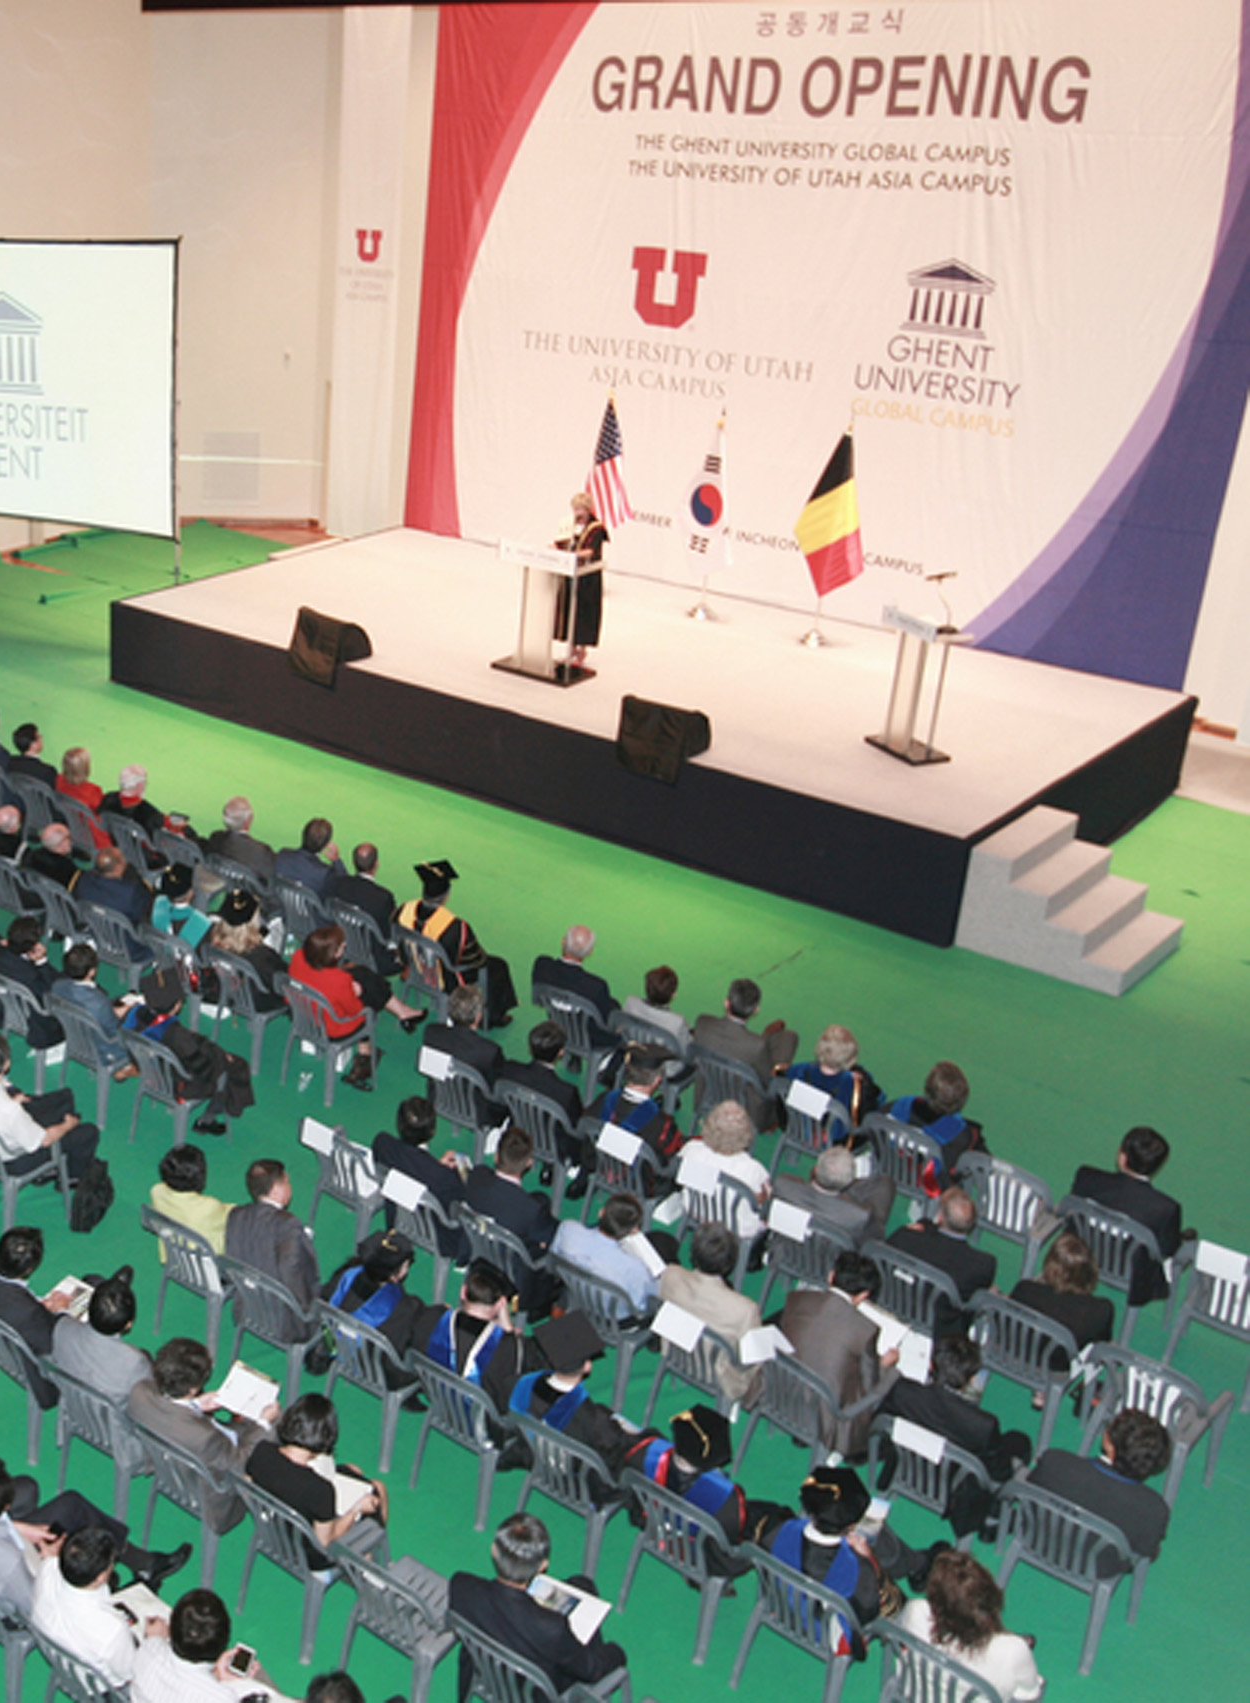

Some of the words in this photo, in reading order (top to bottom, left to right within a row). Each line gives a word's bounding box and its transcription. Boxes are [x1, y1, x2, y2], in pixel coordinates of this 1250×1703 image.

[592, 54, 782, 115] GRAND
[800, 53, 1092, 124] OPENING
[635, 133, 665, 151] THE
[670, 134, 730, 155] GHENT
[735, 139, 838, 160] UNIVERSITY
[843, 142, 918, 162] GLOBAL
[924, 142, 1011, 167] CAMPUS
[628, 159, 658, 177] THE
[662, 160, 768, 184] UNIVERSITY
[772, 167, 802, 186] OF
[808, 168, 862, 188] UTAH
[867, 170, 914, 190] ASIA
[920, 170, 1012, 196] CAMPUS
[355, 228, 383, 263] U
[631, 245, 708, 330] U
[523, 330, 562, 353] THE
[567, 334, 701, 369] UNIVERSITY
[705, 350, 737, 374] OF
[744, 355, 813, 382] UTAH
[887, 334, 995, 373] GHENT
[589, 365, 632, 387] ASIA
[638, 369, 726, 399] CAMPUS
[854, 363, 1021, 409] UNIVERSITY
[851, 397, 925, 424] GLOBAL
[929, 406, 1015, 438] CAMPUS
[864, 551, 923, 575] CAMPUS
